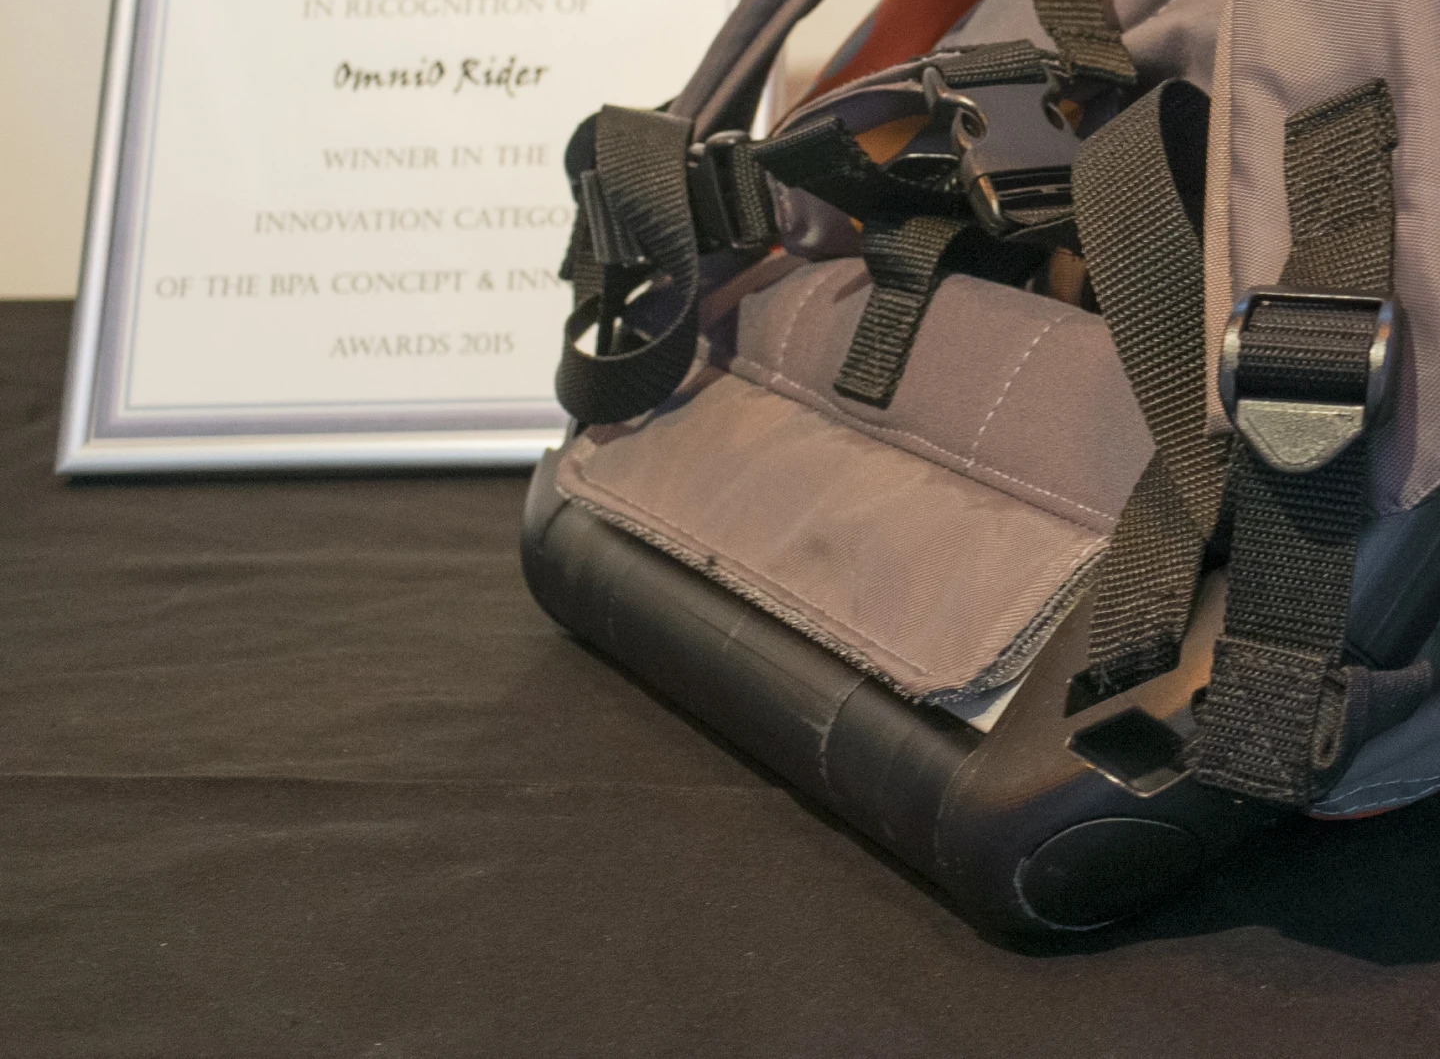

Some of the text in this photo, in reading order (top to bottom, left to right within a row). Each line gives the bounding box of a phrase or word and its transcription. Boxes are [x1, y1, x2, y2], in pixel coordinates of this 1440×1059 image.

[453, 55, 551, 98] Rider
[321, 143, 550, 172] WINNER IN THE
[253, 205, 571, 235] INNOVATION CATEGO
[154, 275, 196, 300] OF
[204, 273, 261, 299] THE
[268, 272, 321, 298] BPA
[329, 268, 467, 296] CONCEPT
[477, 269, 496, 292] &
[329, 331, 516, 359] AWARDS 2015
